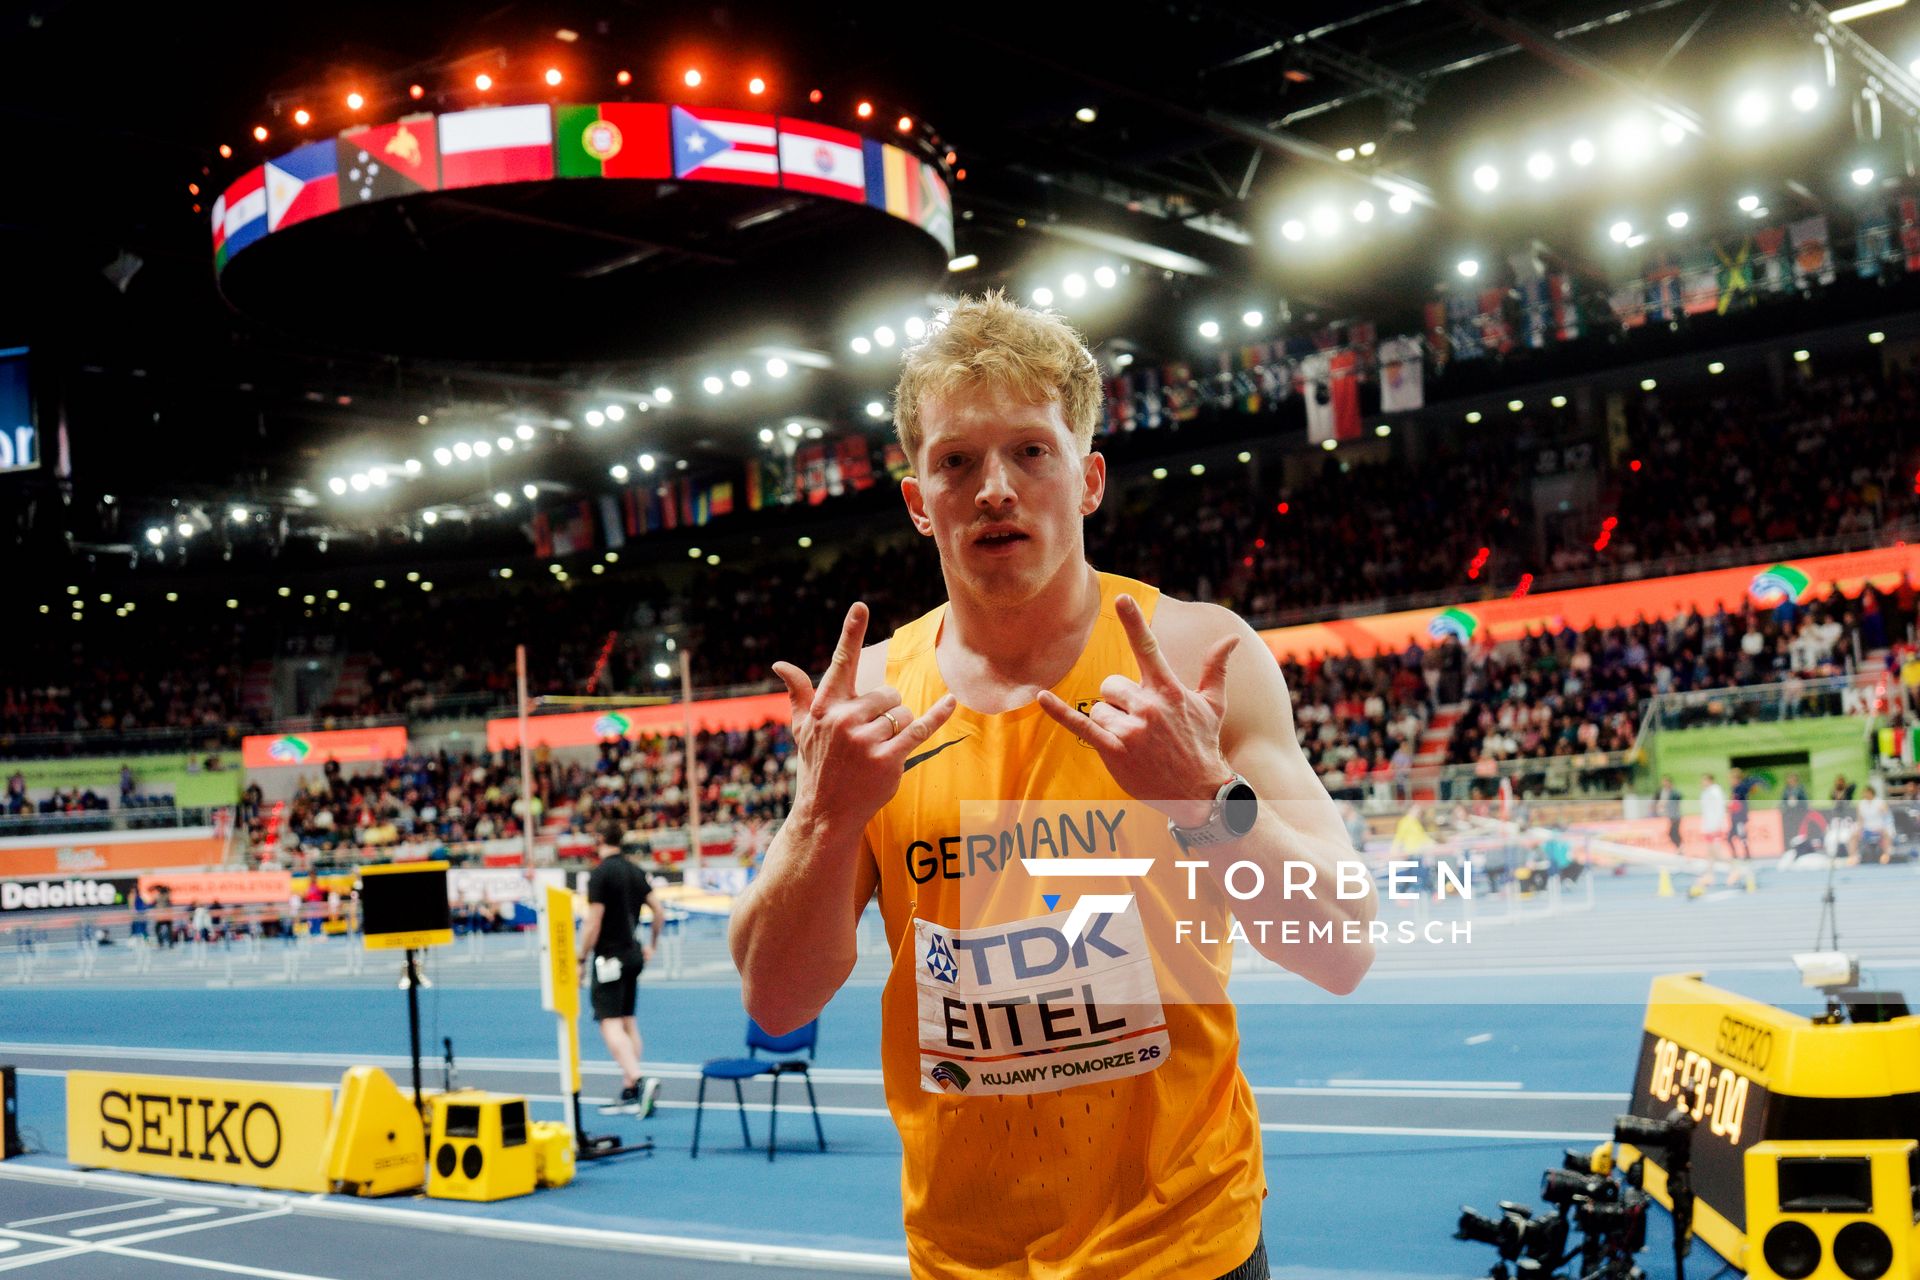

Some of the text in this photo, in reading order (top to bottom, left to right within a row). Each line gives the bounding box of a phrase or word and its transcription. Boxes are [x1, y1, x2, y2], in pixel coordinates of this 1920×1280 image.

[906, 809, 1126, 884] GERMANY
[952, 912, 1129, 986] TDK
[943, 983, 1126, 1050] EITEL
[1716, 1013, 1773, 1072] SEIKO
[980, 1045, 1161, 1086] KUJAWY POMORZE 26
[100, 1089, 282, 1169] SEIKO
